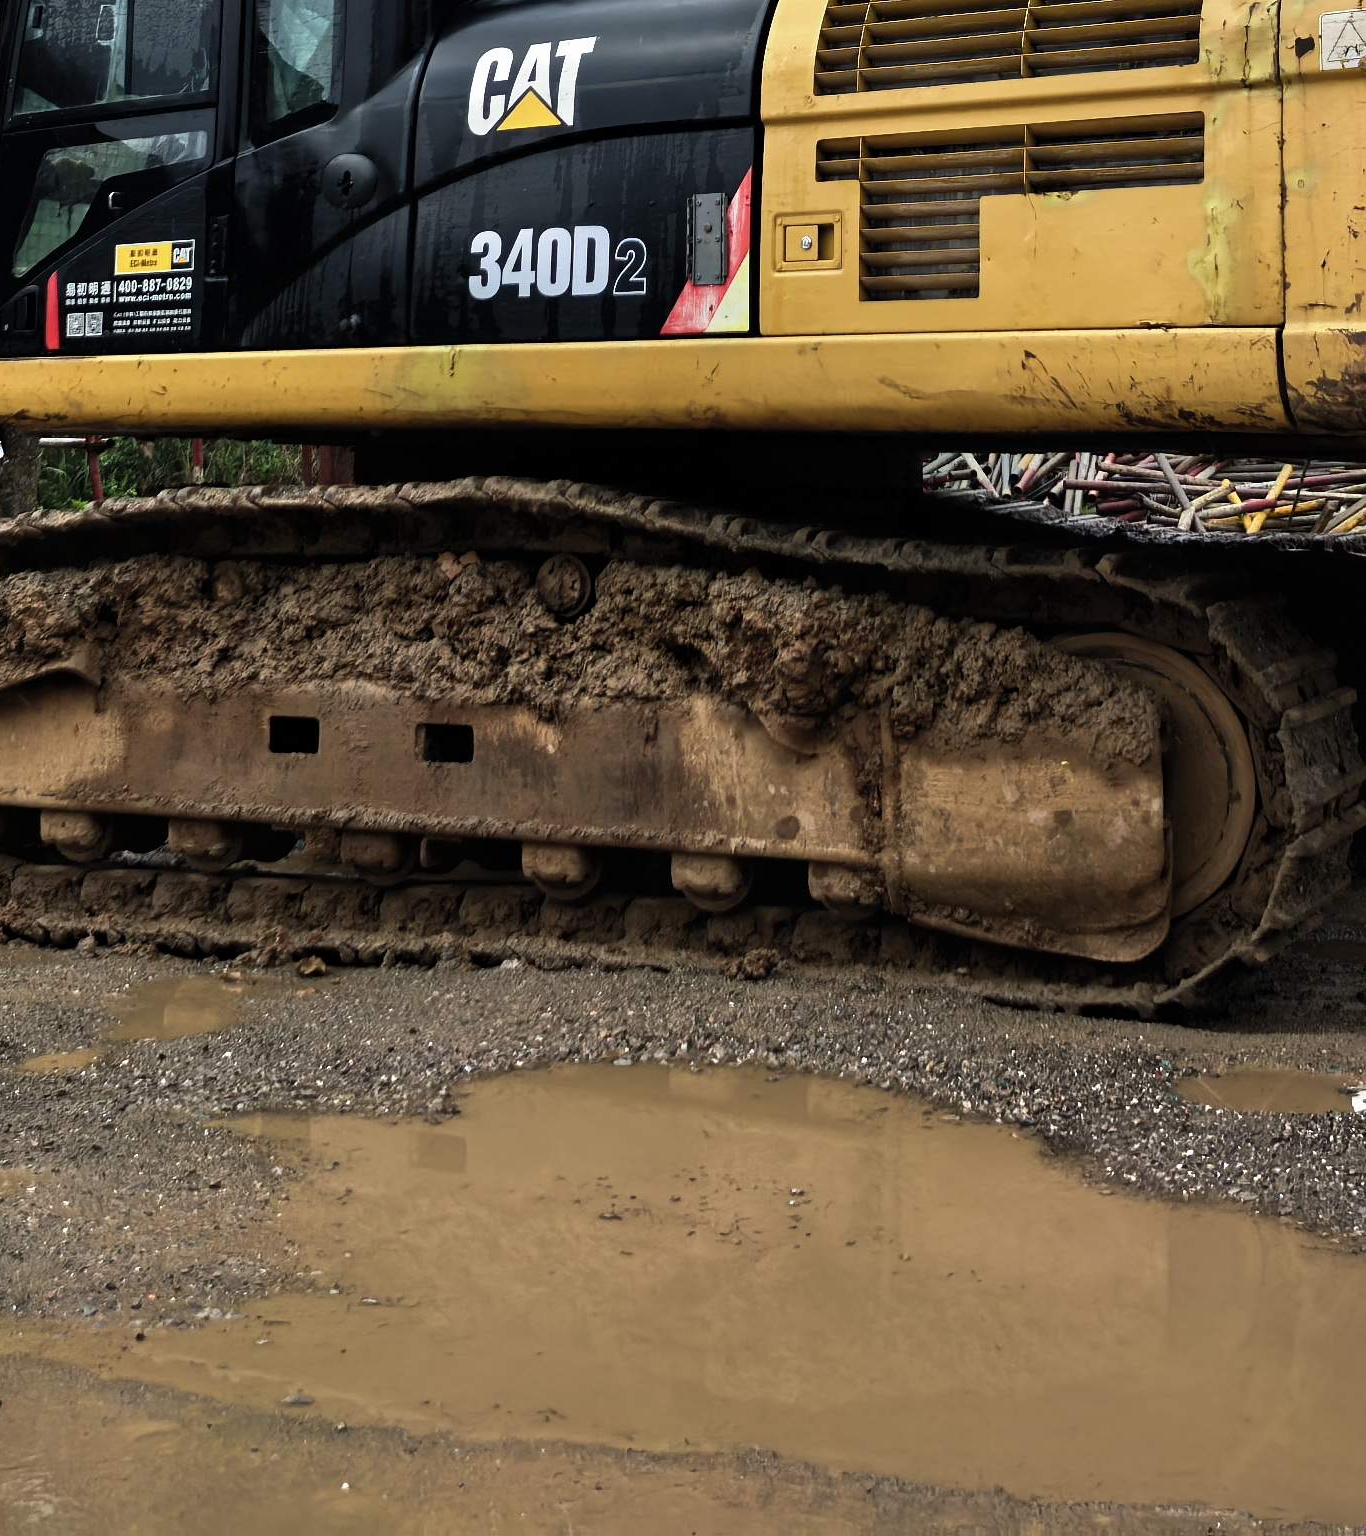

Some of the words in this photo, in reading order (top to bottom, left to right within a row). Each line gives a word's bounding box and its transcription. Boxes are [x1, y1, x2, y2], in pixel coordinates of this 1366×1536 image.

[467, 36, 598, 136] CAT
[173, 247, 192, 264] CAT
[65, 280, 112, 297] 易初明通
[118, 276, 193, 294] 400-887-0829
